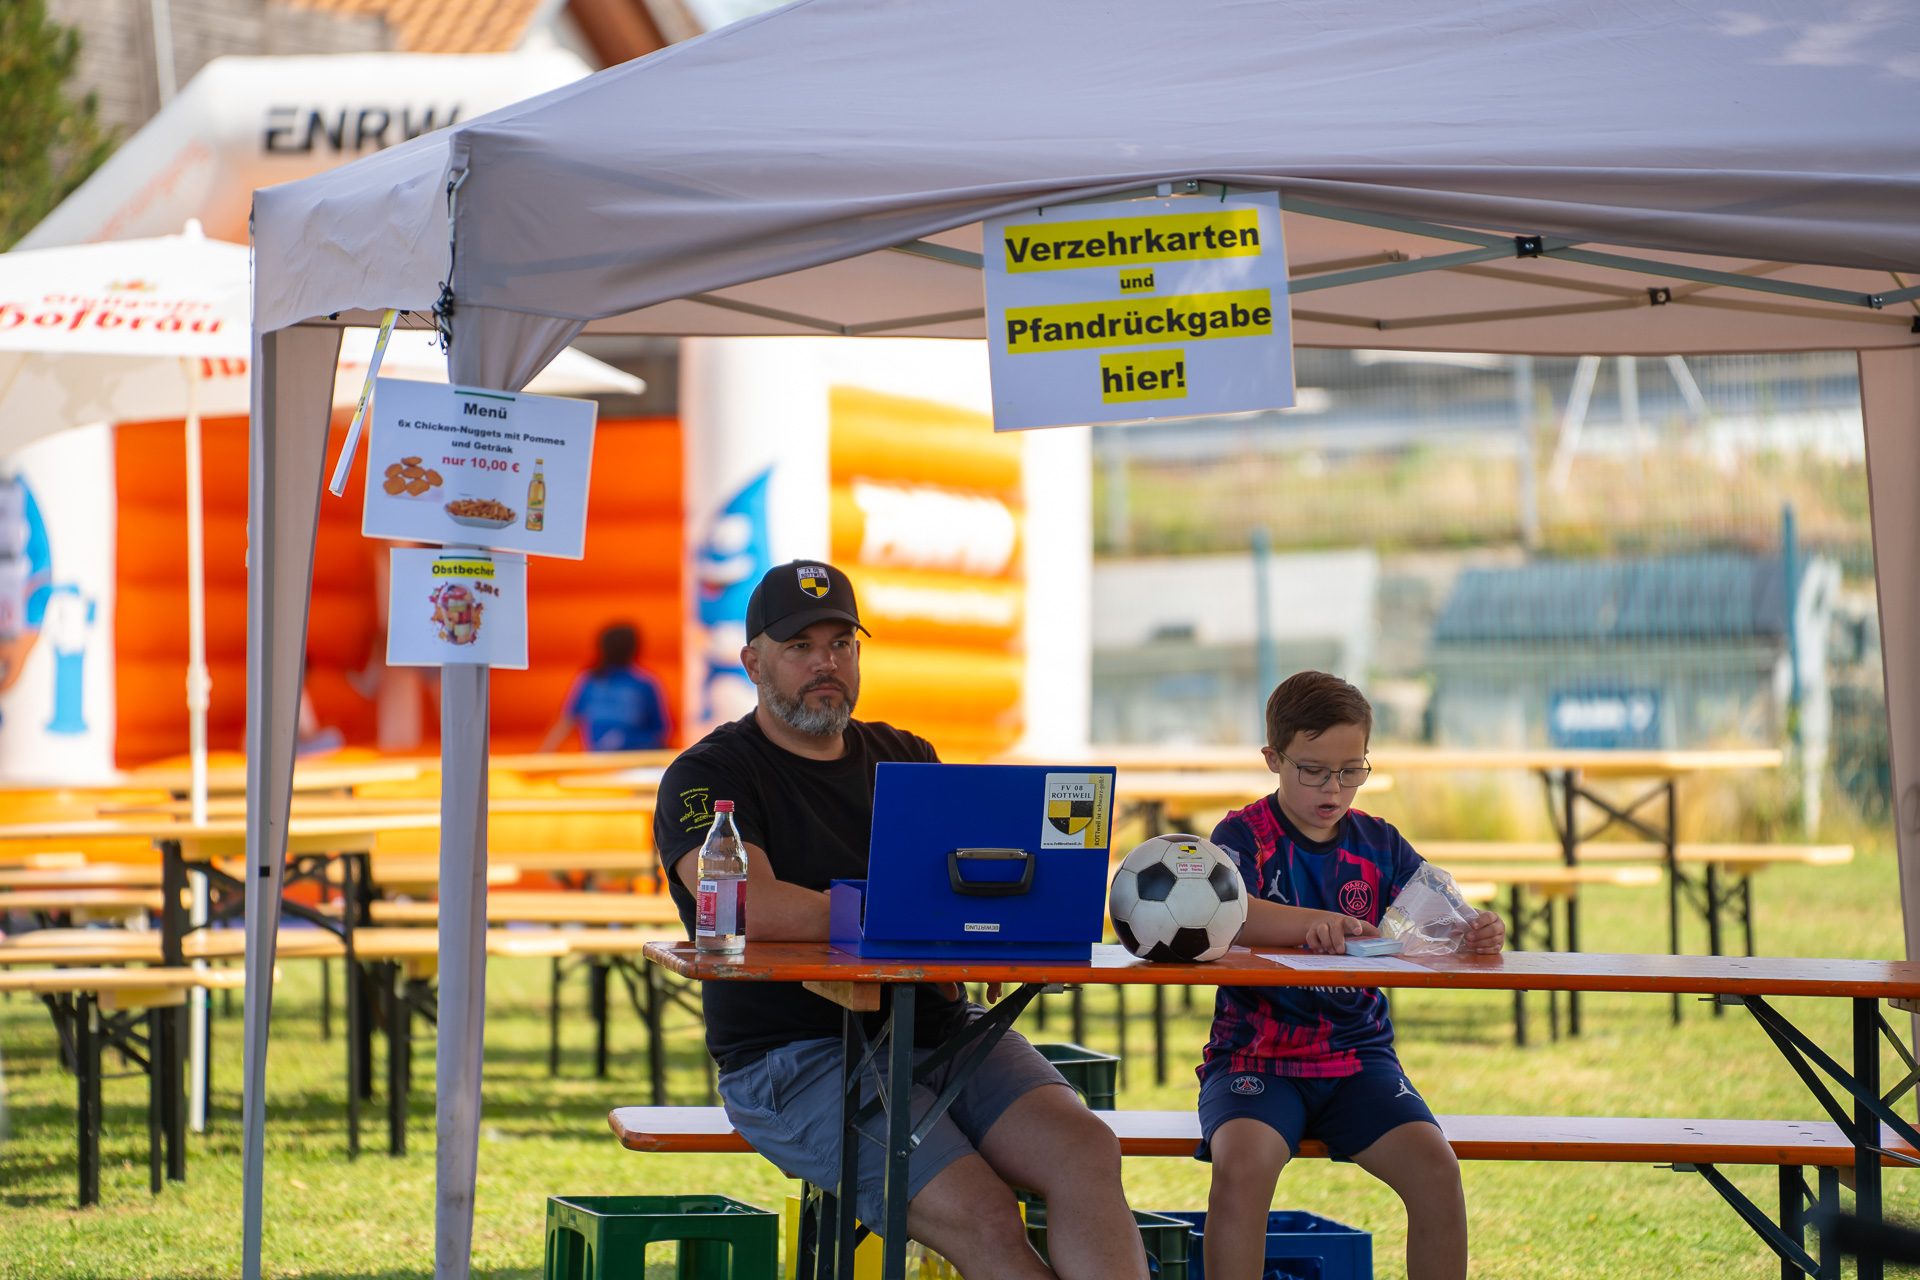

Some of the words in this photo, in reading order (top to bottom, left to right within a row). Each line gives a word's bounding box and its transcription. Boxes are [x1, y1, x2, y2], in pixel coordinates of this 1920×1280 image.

[264, 106, 461, 152] ENRW
[1005, 225, 1260, 264] Verzehrkarten
[1120, 273, 1155, 290] und
[1007, 303, 1272, 344] Pfandrückgabe
[1102, 362, 1185, 393] hier!
[463, 402, 508, 420] Menü
[398, 419, 411, 429] 6x
[414, 420, 502, 440] Chicken-Nuggets
[504, 431, 520, 441] mit
[523, 433, 566, 446] Pommes
[451, 439, 471, 449] und
[474, 441, 513, 454] Getränk
[442, 456, 466, 466] nur
[471, 457, 508, 472] 10,00
[512, 462, 520, 473] €
[432, 564, 495, 577] Obstbecher
[1344, 881, 1369, 892] PARIS
